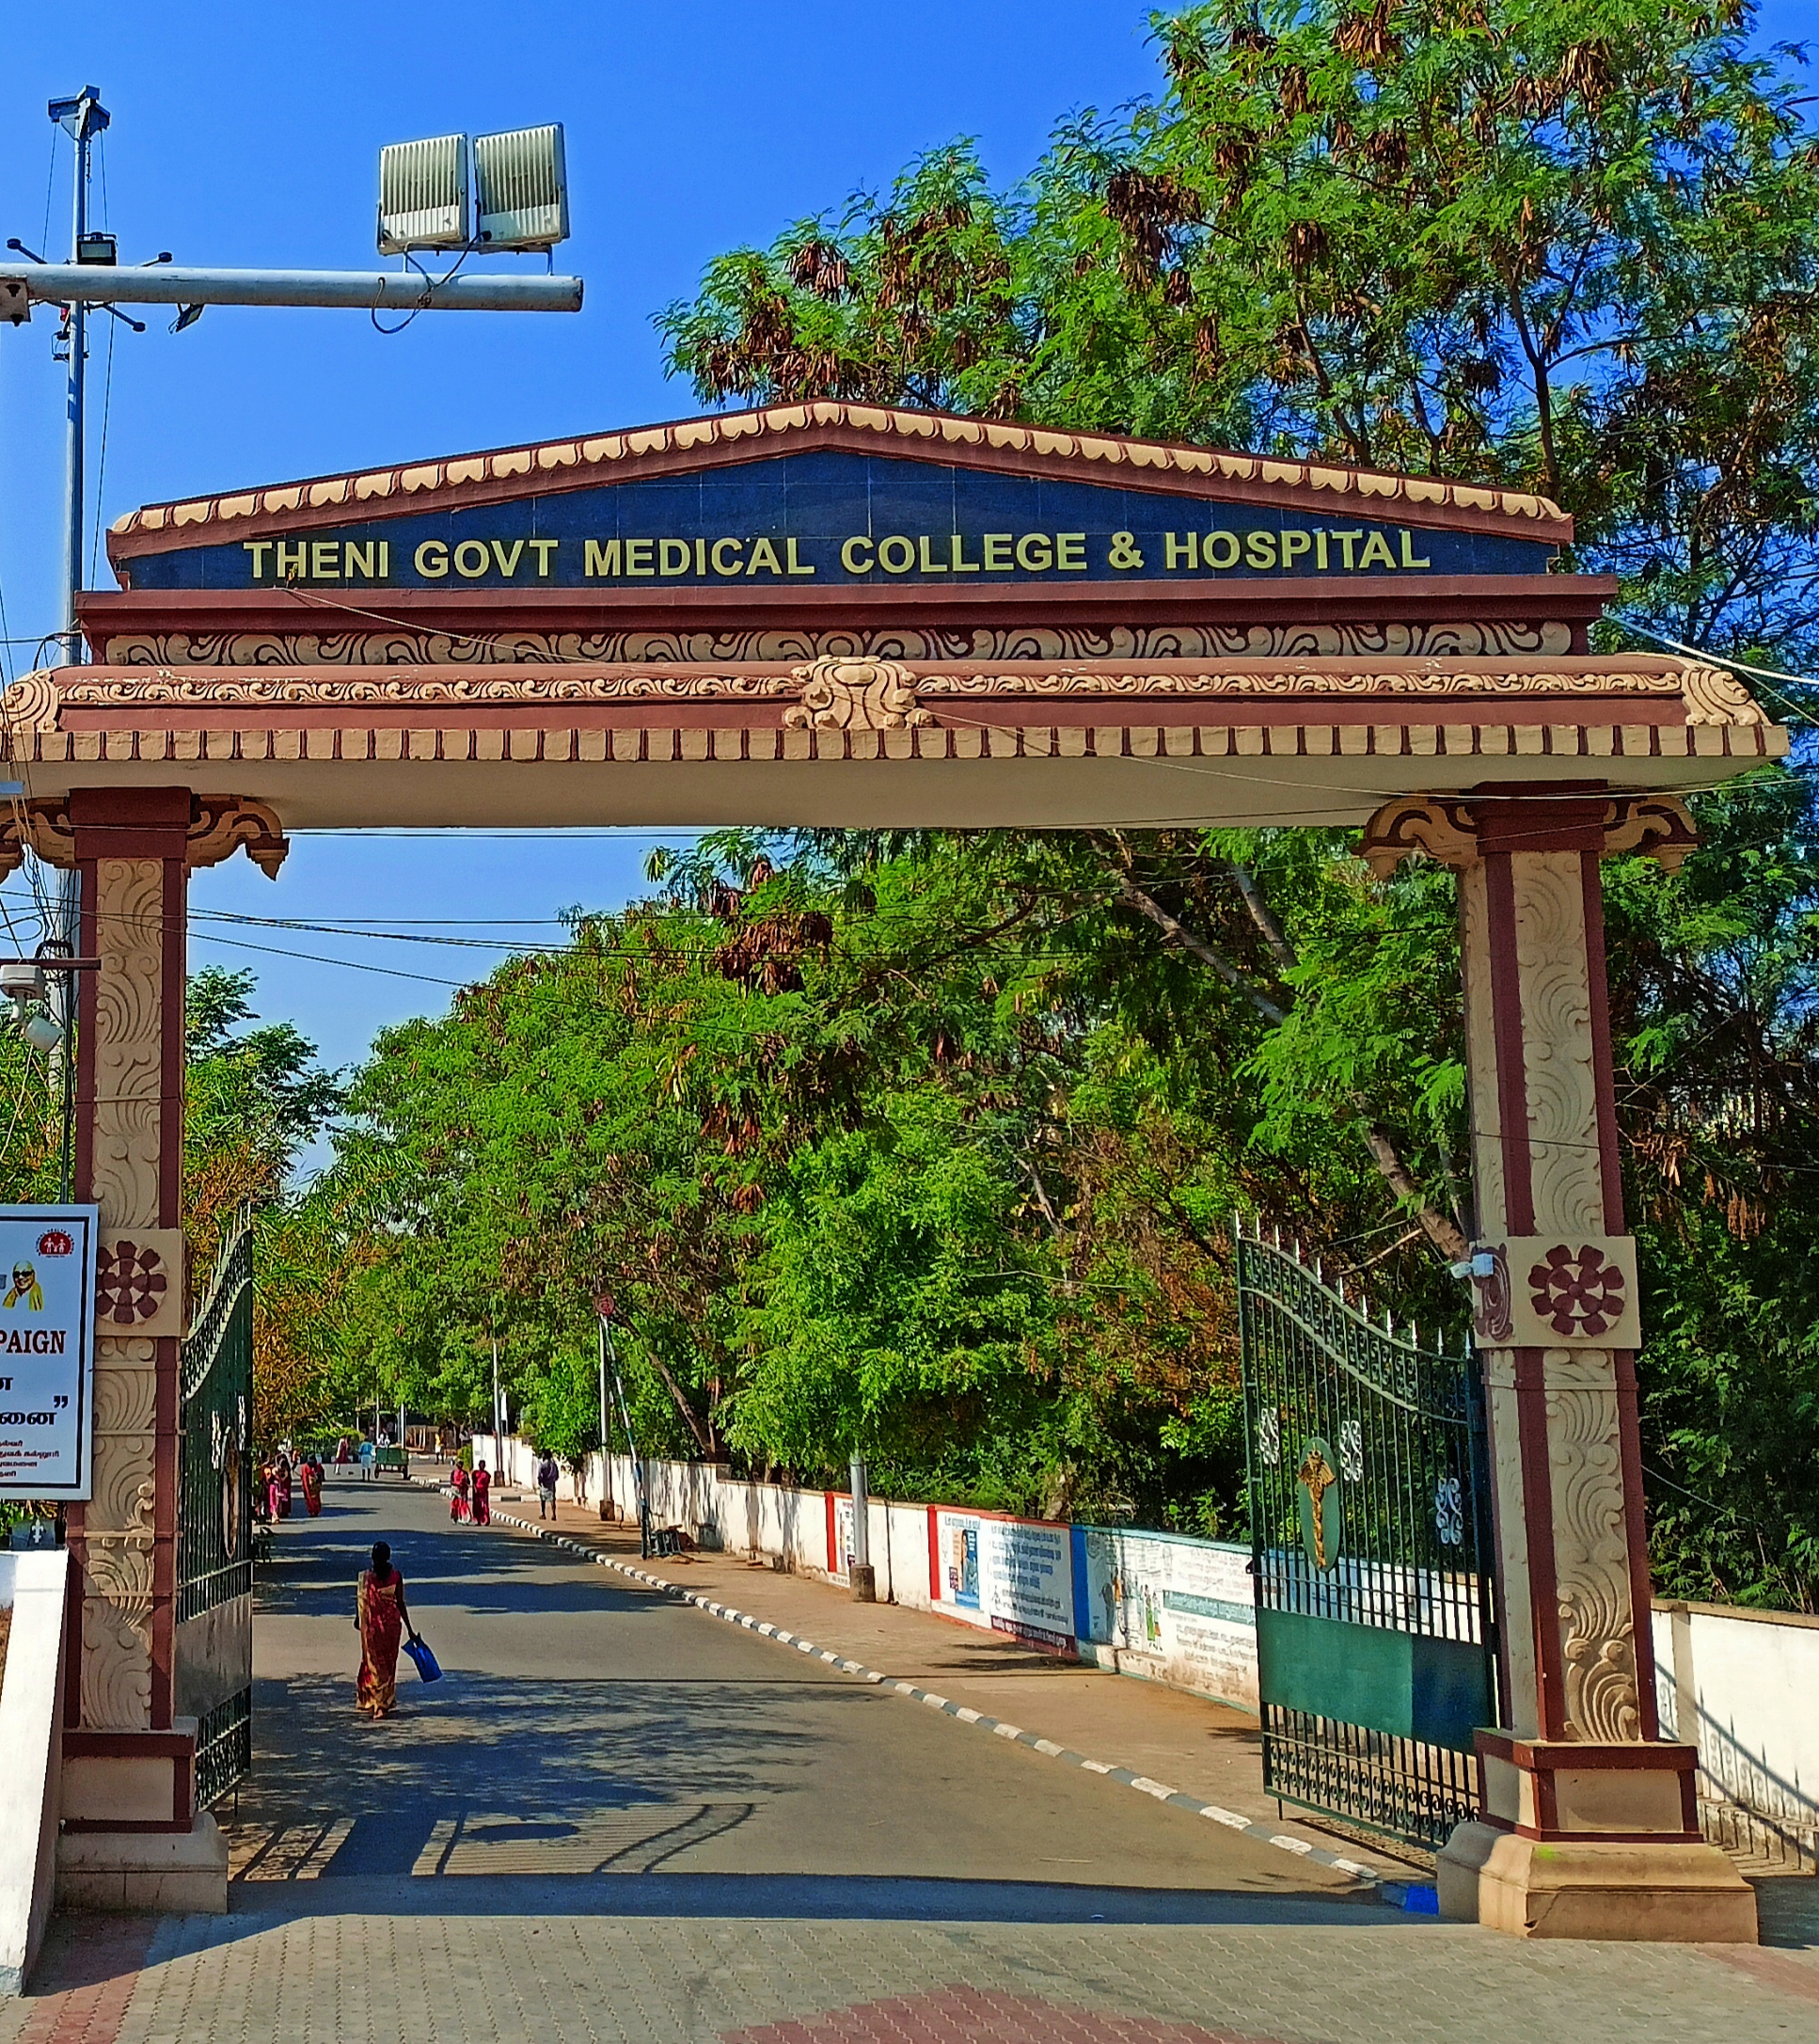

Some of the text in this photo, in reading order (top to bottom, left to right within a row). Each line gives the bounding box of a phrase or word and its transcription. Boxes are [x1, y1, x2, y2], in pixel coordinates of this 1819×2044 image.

[242, 530, 1431, 579] THENI GOVT MEDICAL COLLEGE & HOSPITAL
